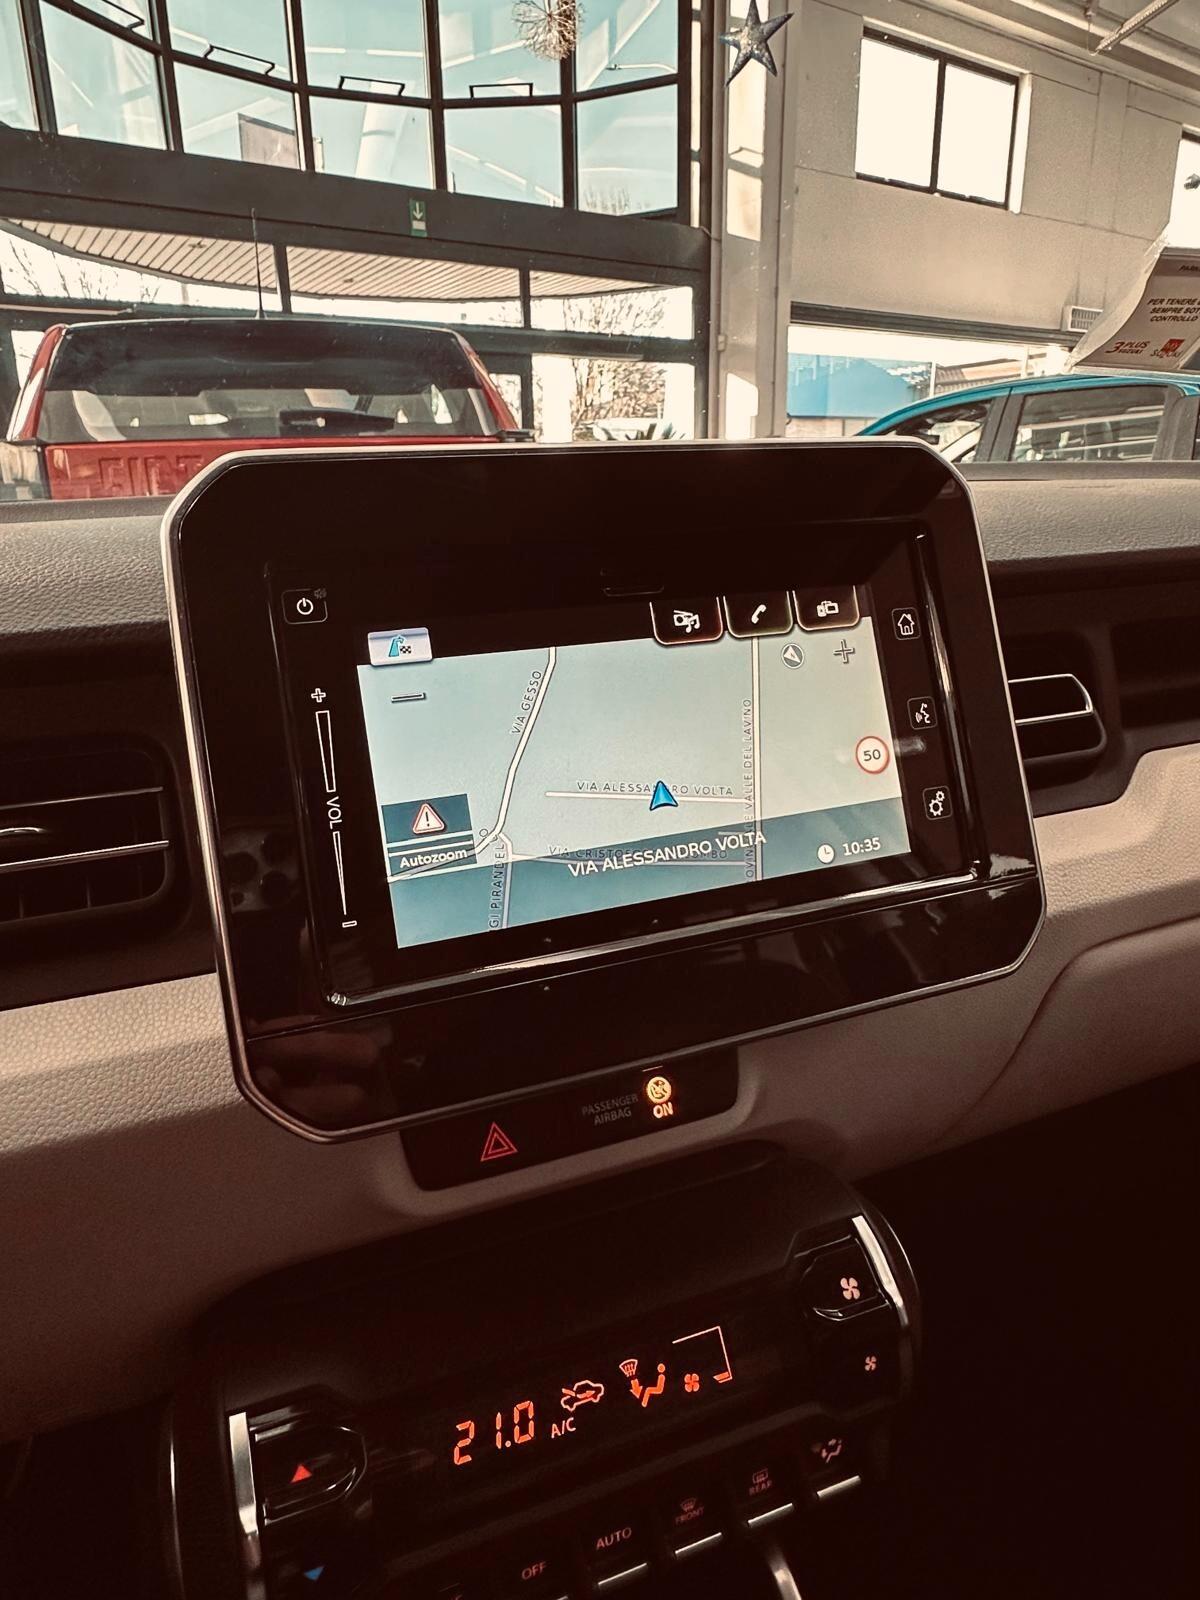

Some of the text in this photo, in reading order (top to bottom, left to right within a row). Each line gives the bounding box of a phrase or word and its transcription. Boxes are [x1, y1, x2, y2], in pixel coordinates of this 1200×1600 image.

[1123, 341, 1150, 349] PLUS
[511, 671, 542, 733] VIA GESSO
[743, 699, 752, 740] LAVINO
[743, 744, 753, 768] DEL
[863, 749, 881, 761] 50
[577, 782, 734, 796] VIA ALESSARO VOLTA
[743, 775, 753, 810] VALLE
[326, 796, 342, 829] VOL
[550, 846, 569, 857] VIA
[568, 831, 767, 877] VIA ALESSANDRO VOLTA
[842, 837, 881, 856] 10:35
[400, 849, 468, 869] Autozoom
[581, 1093, 639, 1116] PASSENGER
[652, 1102, 674, 1119] ON
[594, 1106, 632, 1126] AIRBAG
[453, 1400, 535, 1466] 21.0
[551, 1416, 577, 1439] A/C
[748, 1479, 773, 1496] REAR
[675, 1506, 704, 1525] FRONT
[596, 1527, 633, 1550] AUTO
[521, 1561, 547, 1580] OFF
